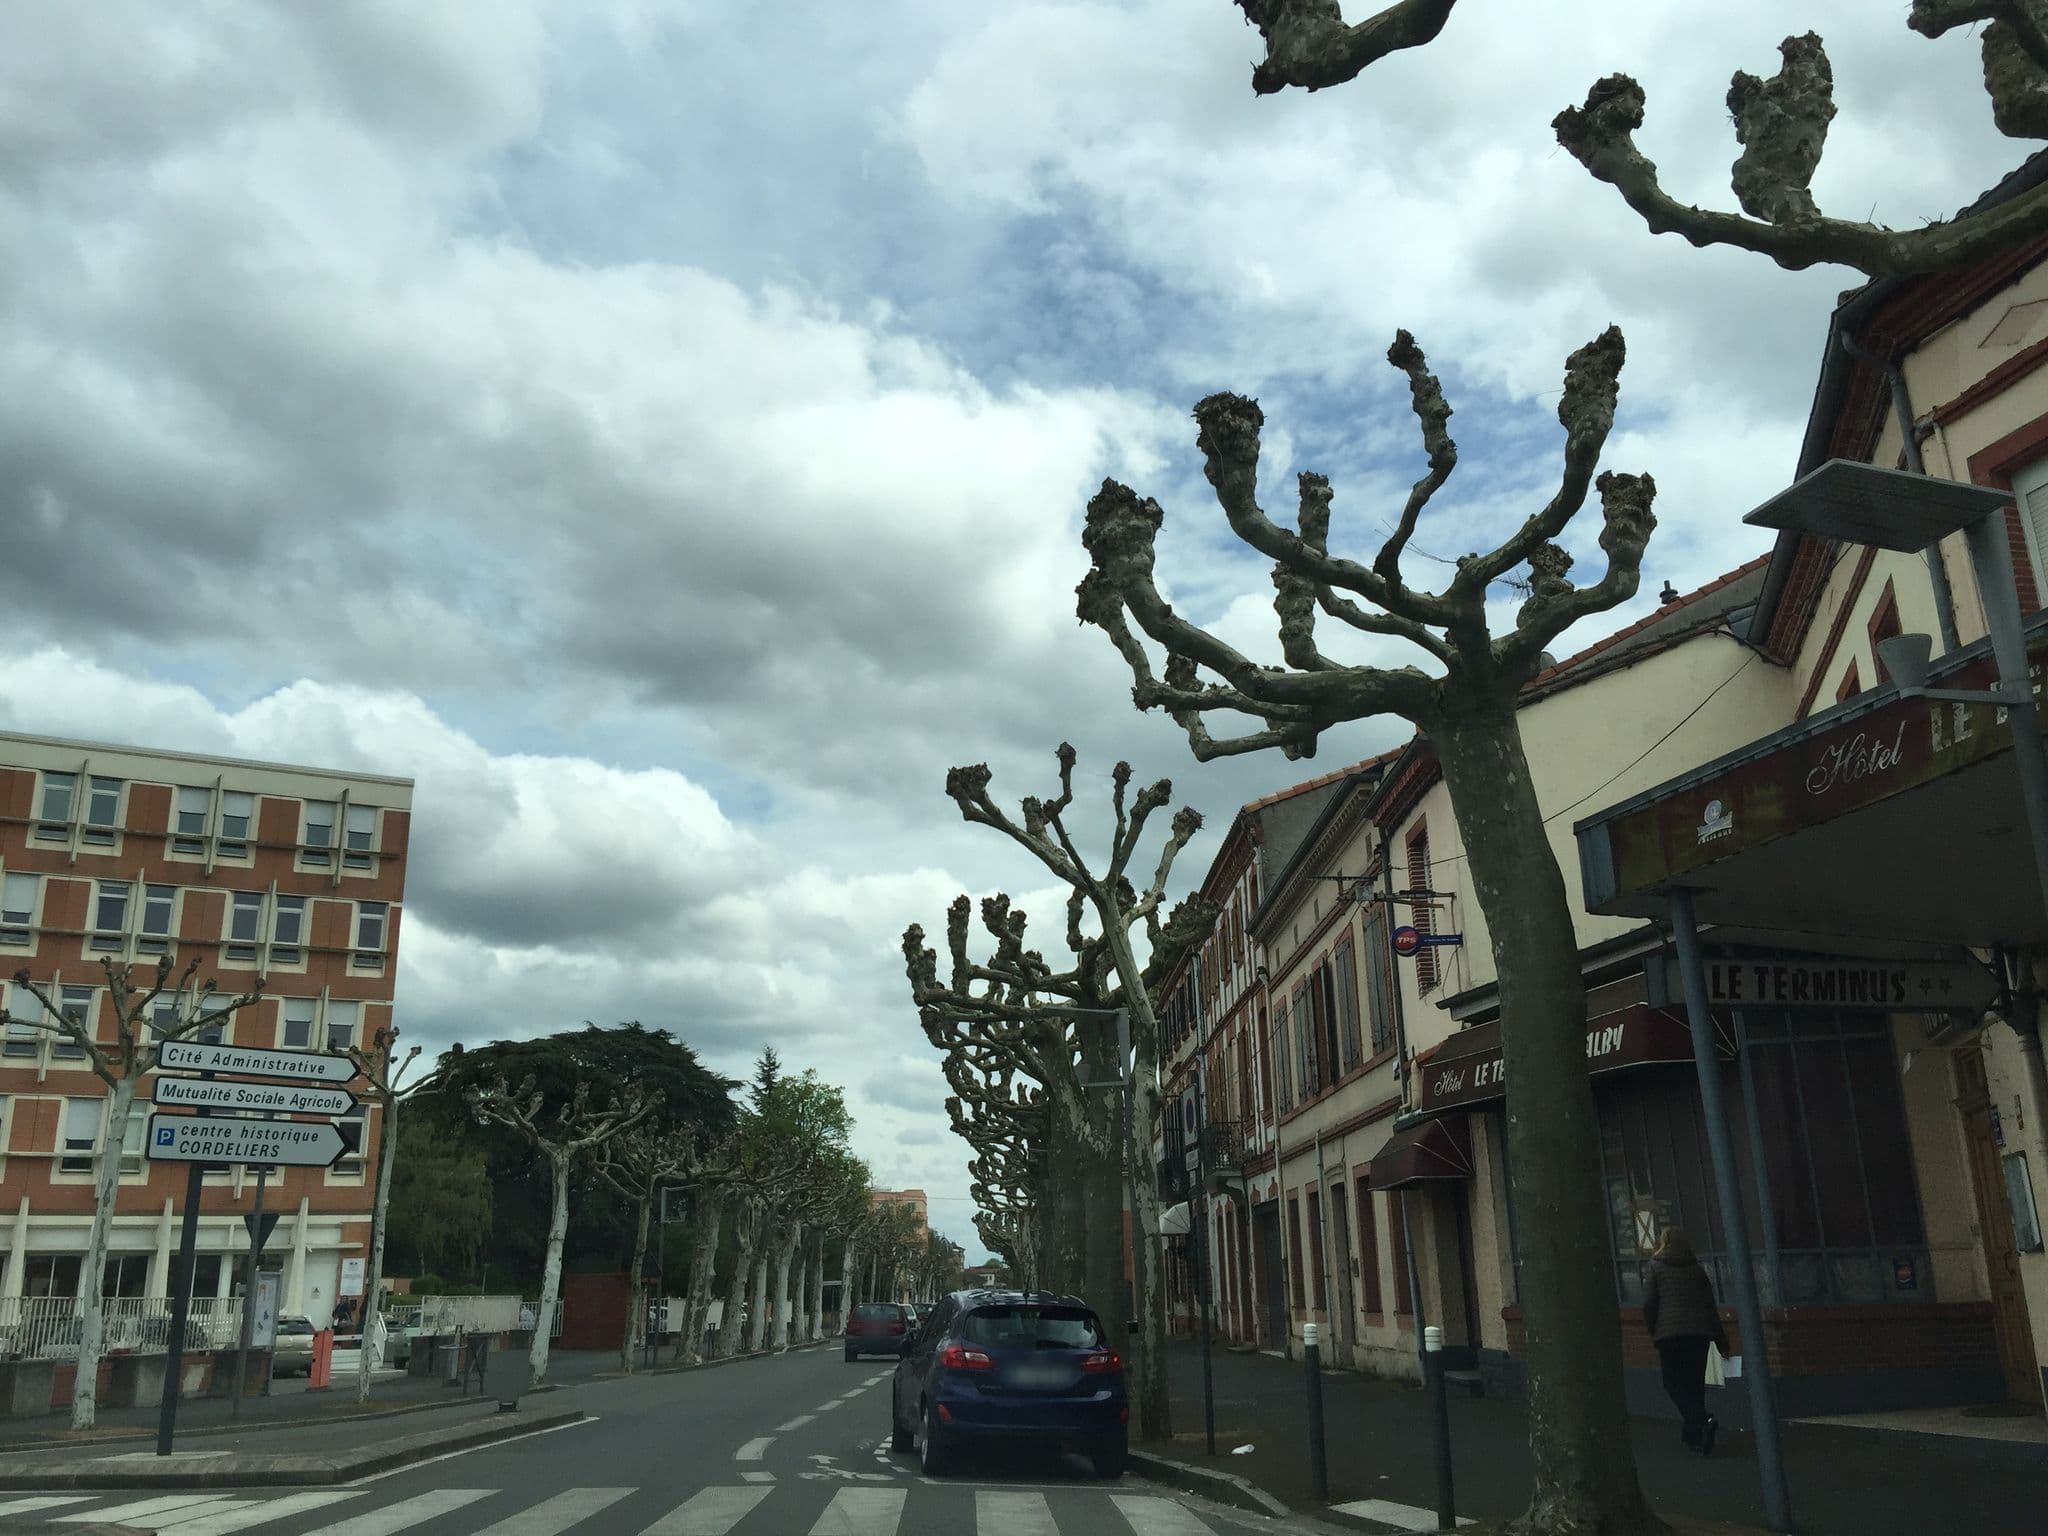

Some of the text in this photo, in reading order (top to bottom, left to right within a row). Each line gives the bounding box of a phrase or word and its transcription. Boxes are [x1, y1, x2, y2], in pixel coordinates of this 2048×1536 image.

[1711, 964, 1906, 1002] LE TERMINUS
[168, 1047, 326, 1075] Cité Administrative
[1474, 1062, 1489, 1088] LE
[162, 1084, 343, 1111] Mutualité Sociale Agricole
[180, 1124, 319, 1145] centre historique
[179, 1140, 281, 1158] CORDELIERS
